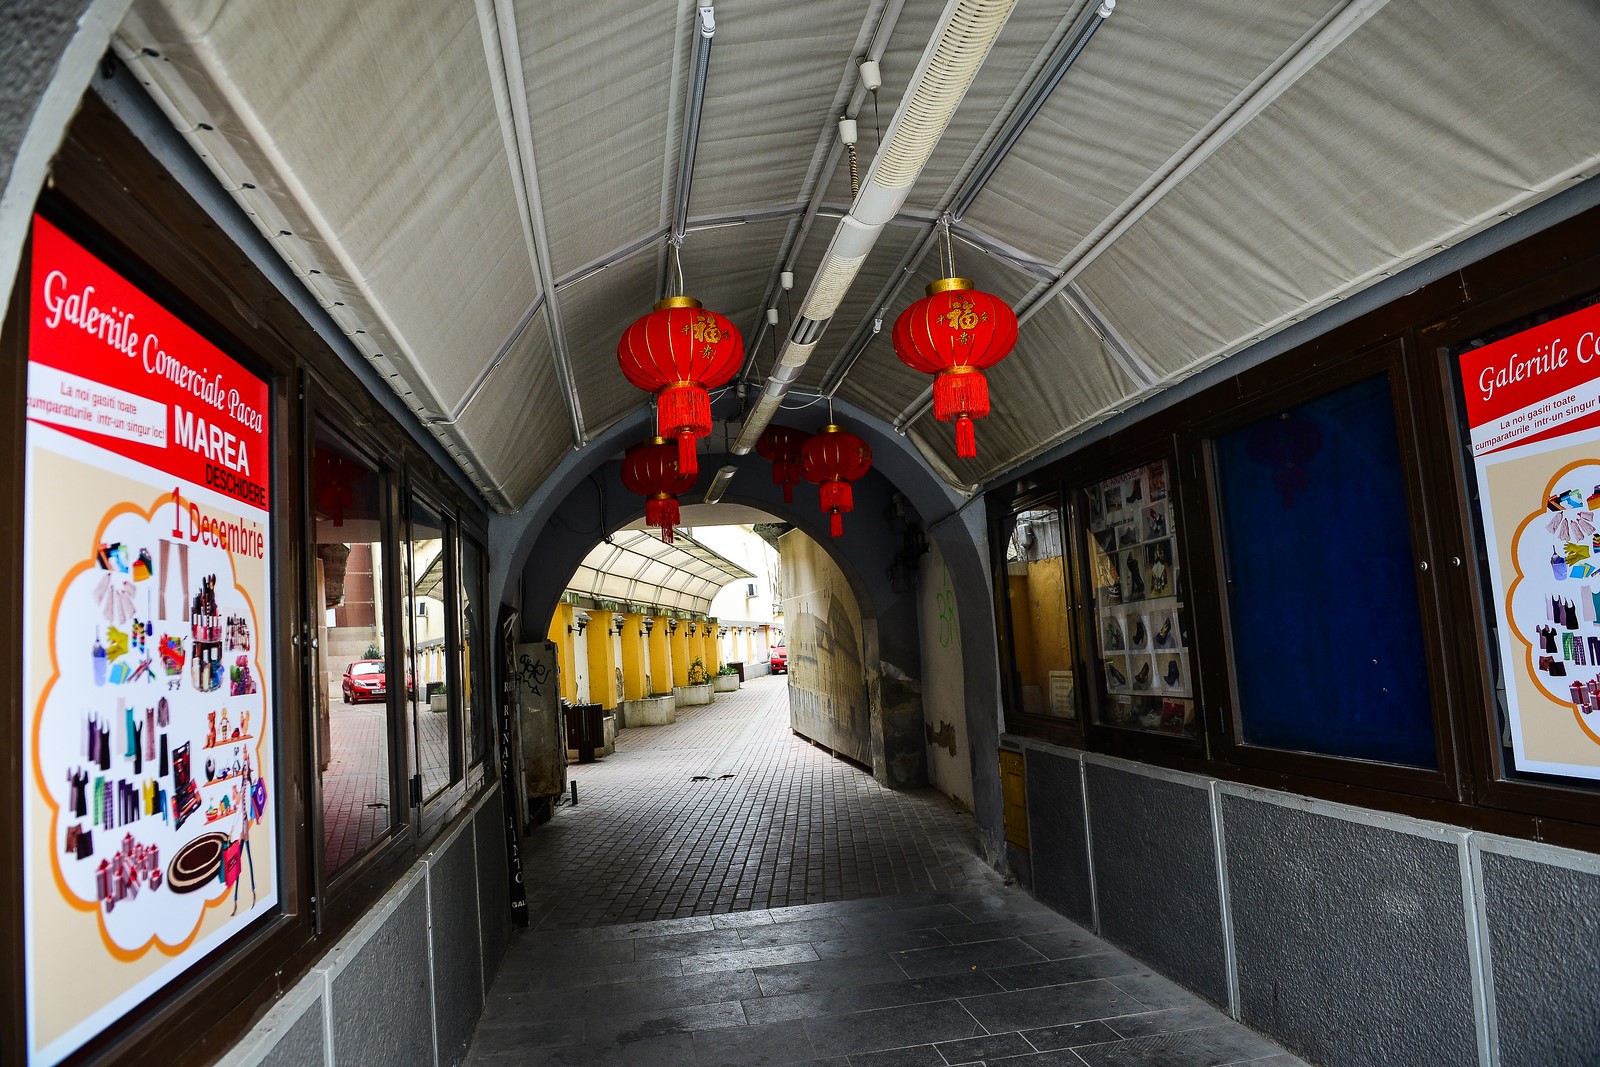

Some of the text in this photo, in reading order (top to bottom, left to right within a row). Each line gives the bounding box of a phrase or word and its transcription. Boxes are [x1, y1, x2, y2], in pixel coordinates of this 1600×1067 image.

[44, 270, 263, 434] Galeriile Comerciale Pacea
[1479, 338, 1569, 401] Galeriile
[60, 382, 137, 415] La noi gasiti toate
[1500, 394, 1576, 430] La noi gasiti toate
[97, 411, 125, 429] intr-un
[127, 420, 151, 437] singur
[151, 425, 165, 440] loc!
[174, 405, 250, 477] MAREA
[1475, 424, 1530, 451] cumparaturile
[1534, 411, 1563, 429] intr-un
[1566, 399, 1596, 416] singur
[205, 463, 266, 507] DESCHIDERE
[172, 487, 264, 560] 1 Decembrie
